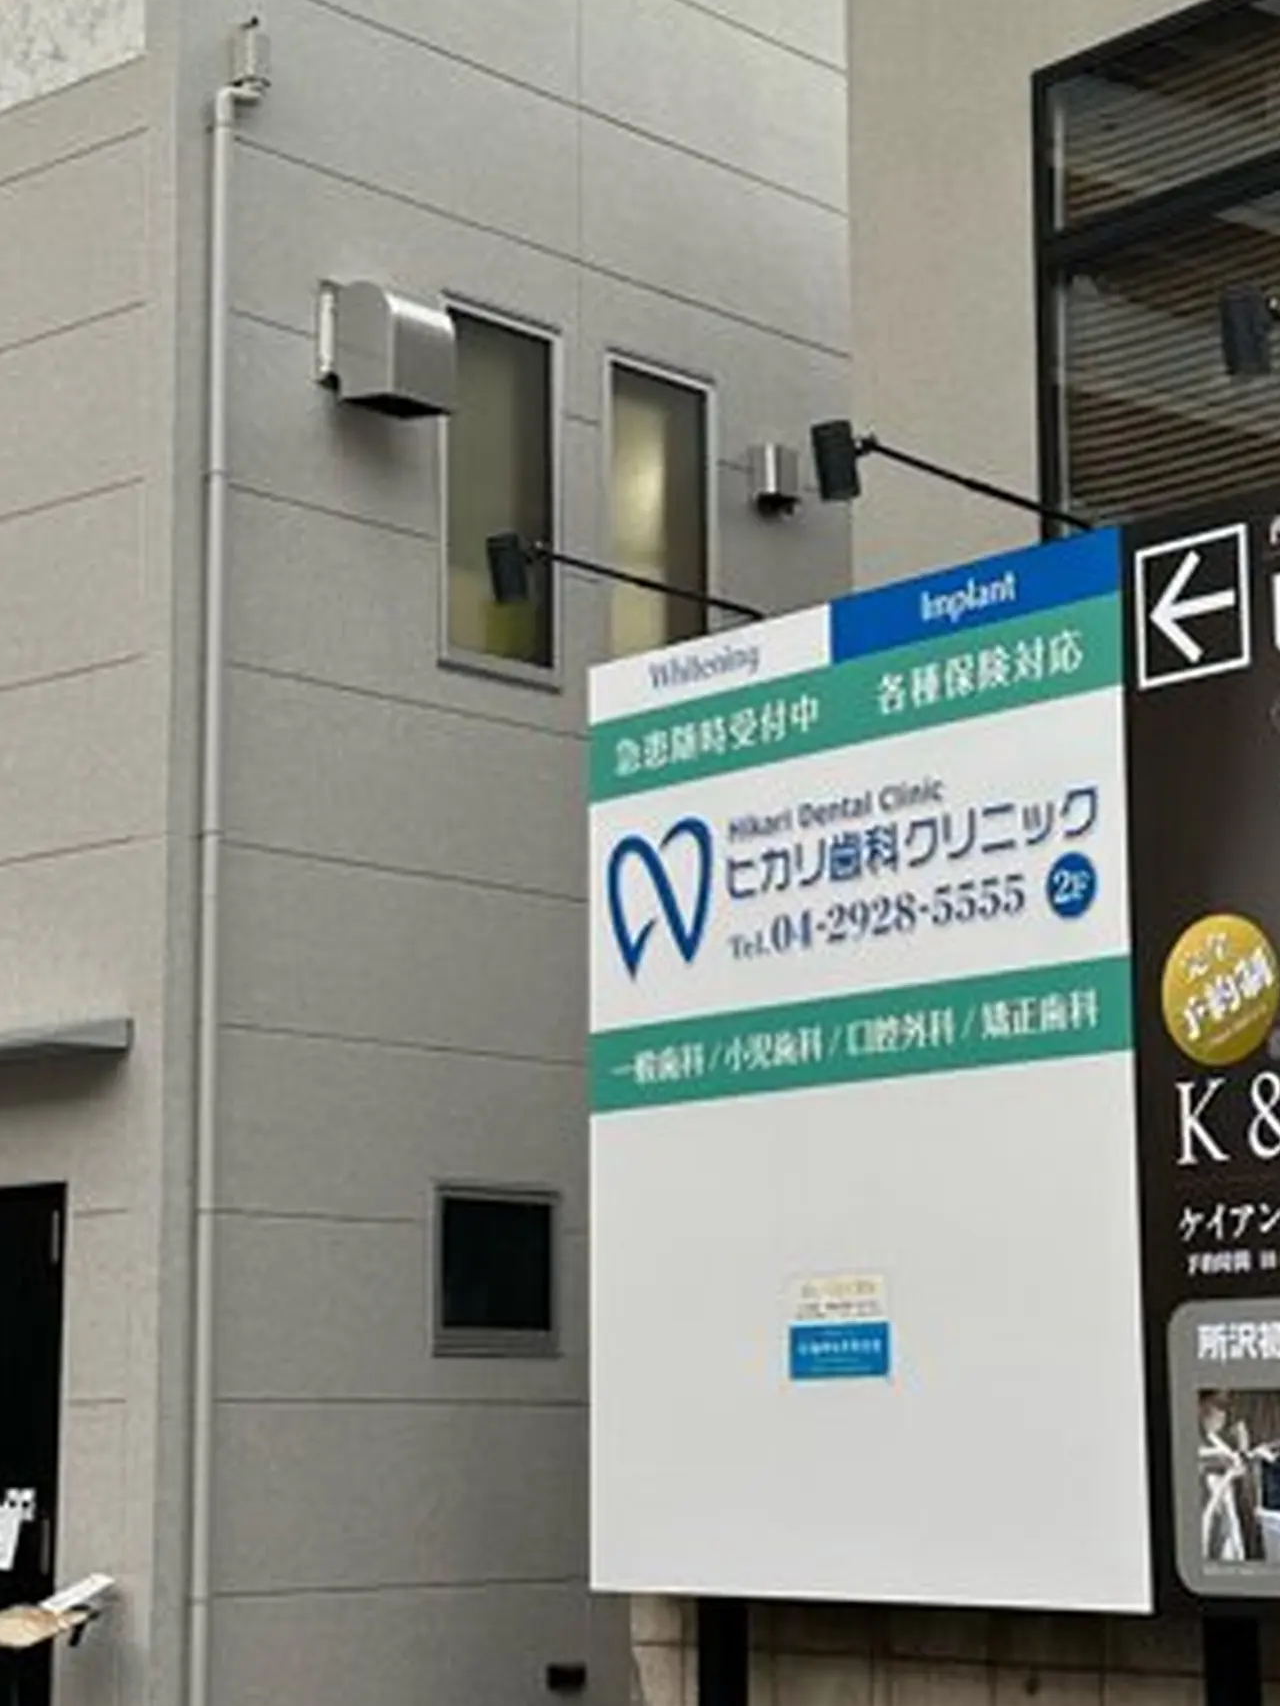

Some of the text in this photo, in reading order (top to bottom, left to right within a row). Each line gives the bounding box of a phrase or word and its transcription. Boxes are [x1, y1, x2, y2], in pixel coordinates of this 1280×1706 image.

[922, 571, 1015, 623] Implant
[648, 644, 760, 689] Whitening
[615, 629, 1083, 776] 急患随時受付中 各種保険対応
[728, 780, 944, 842] Hikari Dental Clinic
[726, 787, 1097, 899] ヒカリ歯科クリニック
